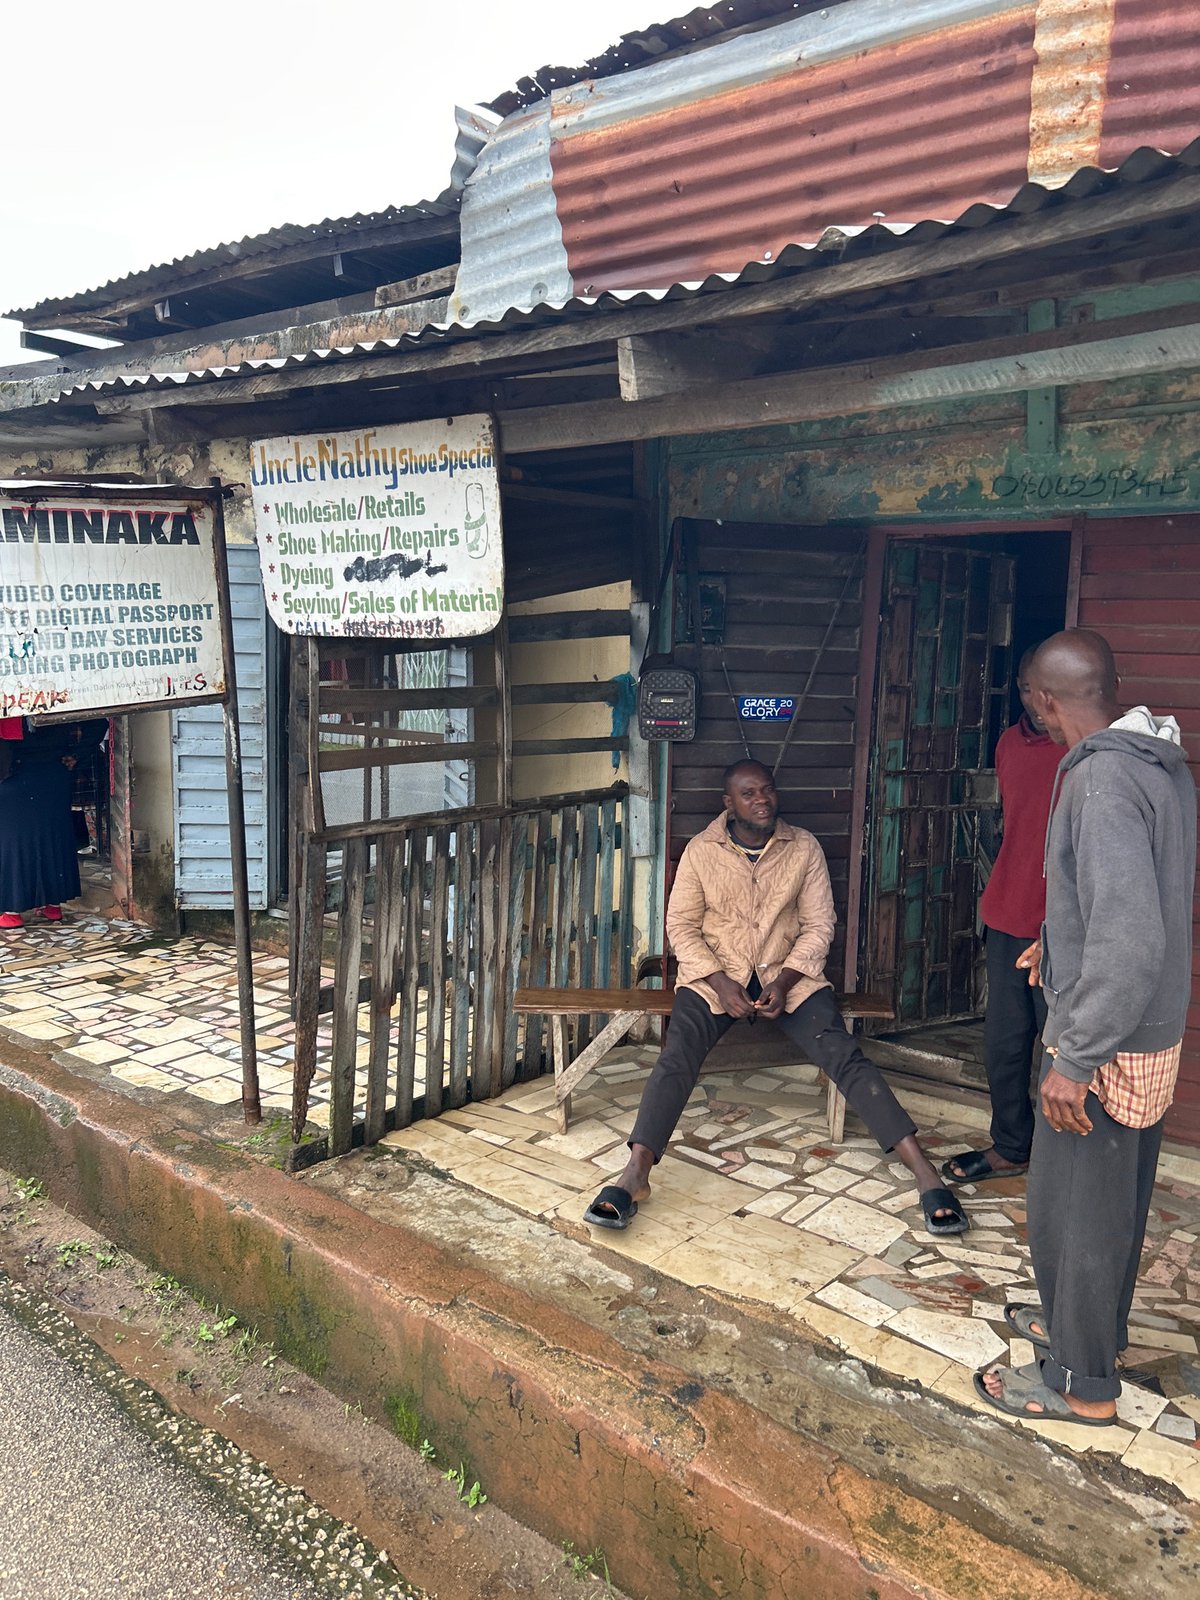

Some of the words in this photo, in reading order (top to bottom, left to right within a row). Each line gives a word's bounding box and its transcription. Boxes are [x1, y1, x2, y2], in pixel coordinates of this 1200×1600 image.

[274, 491, 426, 525] Wholesale/Retails
[0, 506, 200, 545] AMINAKA
[277, 532, 317, 555] Shoe
[321, 523, 460, 557] Making/Repairs
[280, 561, 334, 590] Dyeing
[60, 582, 162, 601] COVERAGE
[283, 590, 396, 620] Sewing/Sales
[400, 589, 418, 614] of
[36, 606, 114, 627] DIGITAL
[118, 603, 214, 624] PASSPORT
[71, 629, 108, 650] DAY
[113, 625, 203, 646] SERVICES
[69, 646, 198, 672] PHOTOGRAPH
[741, 707, 780, 717] GLORY
[744, 698, 776, 707] GRACE
[780, 699, 793, 708] 20
